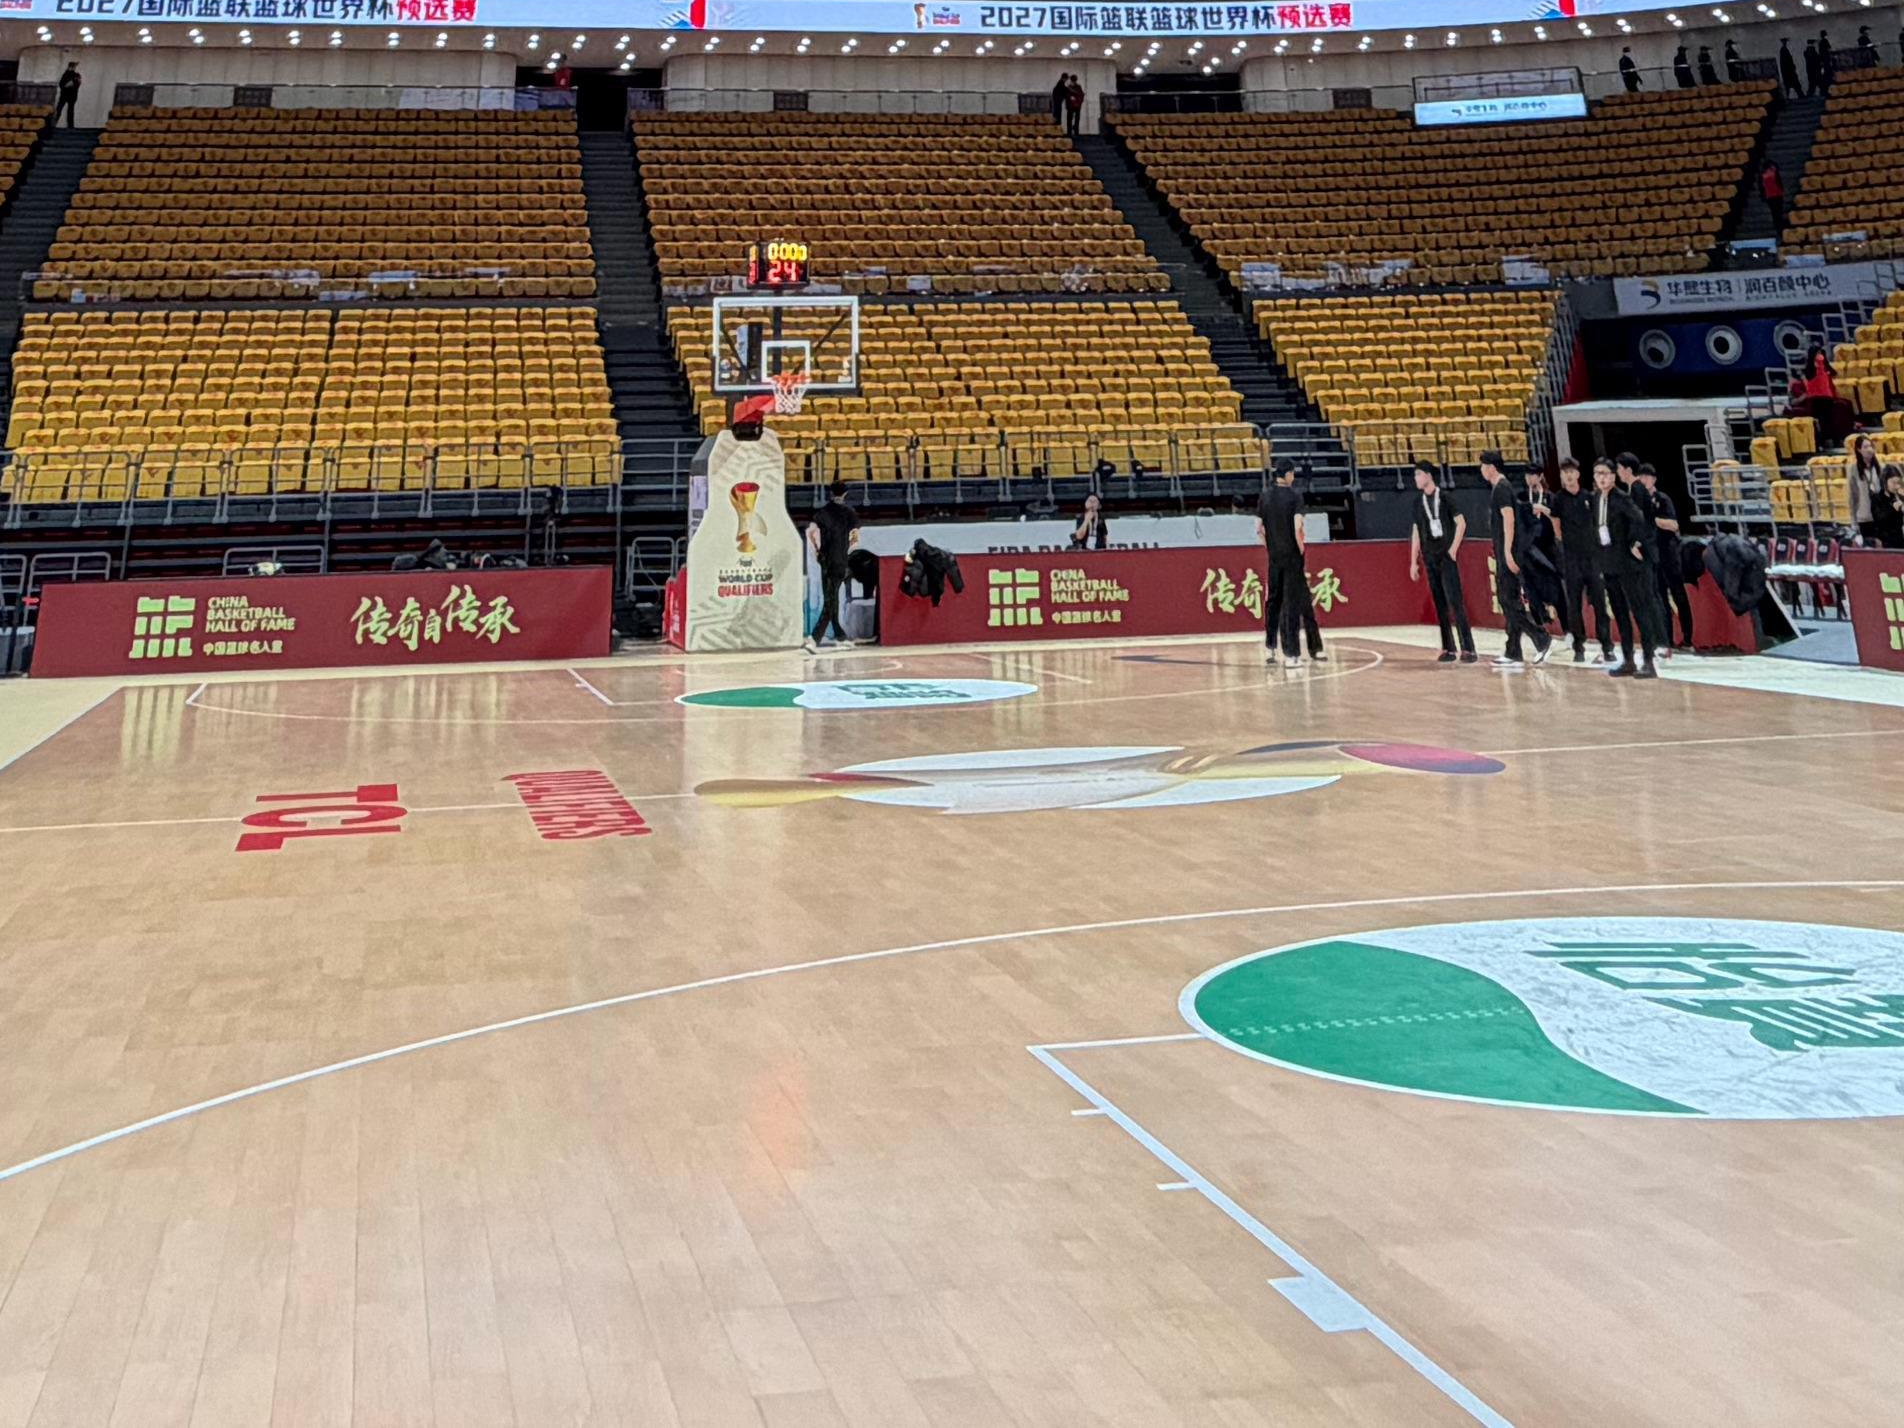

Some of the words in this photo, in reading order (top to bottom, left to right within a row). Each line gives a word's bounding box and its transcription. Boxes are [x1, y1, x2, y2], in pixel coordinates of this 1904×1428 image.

[980, 1, 1354, 30] 2027国际篮联篮球世界杯预选赛
[768, 260, 796, 282] 24
[717, 573, 753, 584] WORLD
[754, 573, 774, 583] CUP
[1050, 568, 1086, 580] CHINA
[717, 583, 774, 598] QUALIFIERS
[1050, 579, 1120, 591] BASKETBALL
[207, 595, 249, 609] CHINA
[1050, 589, 1080, 604] HALL
[1082, 589, 1097, 603] OF
[1099, 588, 1130, 603] FAME
[206, 606, 287, 620] BASKETBALL
[349, 584, 521, 651] 传奇自传承
[204, 618, 240, 633] HALL
[241, 618, 260, 632] OF
[260, 616, 296, 631] FAME
[500, 768, 653, 841] QUALIFIERS
[234, 782, 408, 853] TCL
